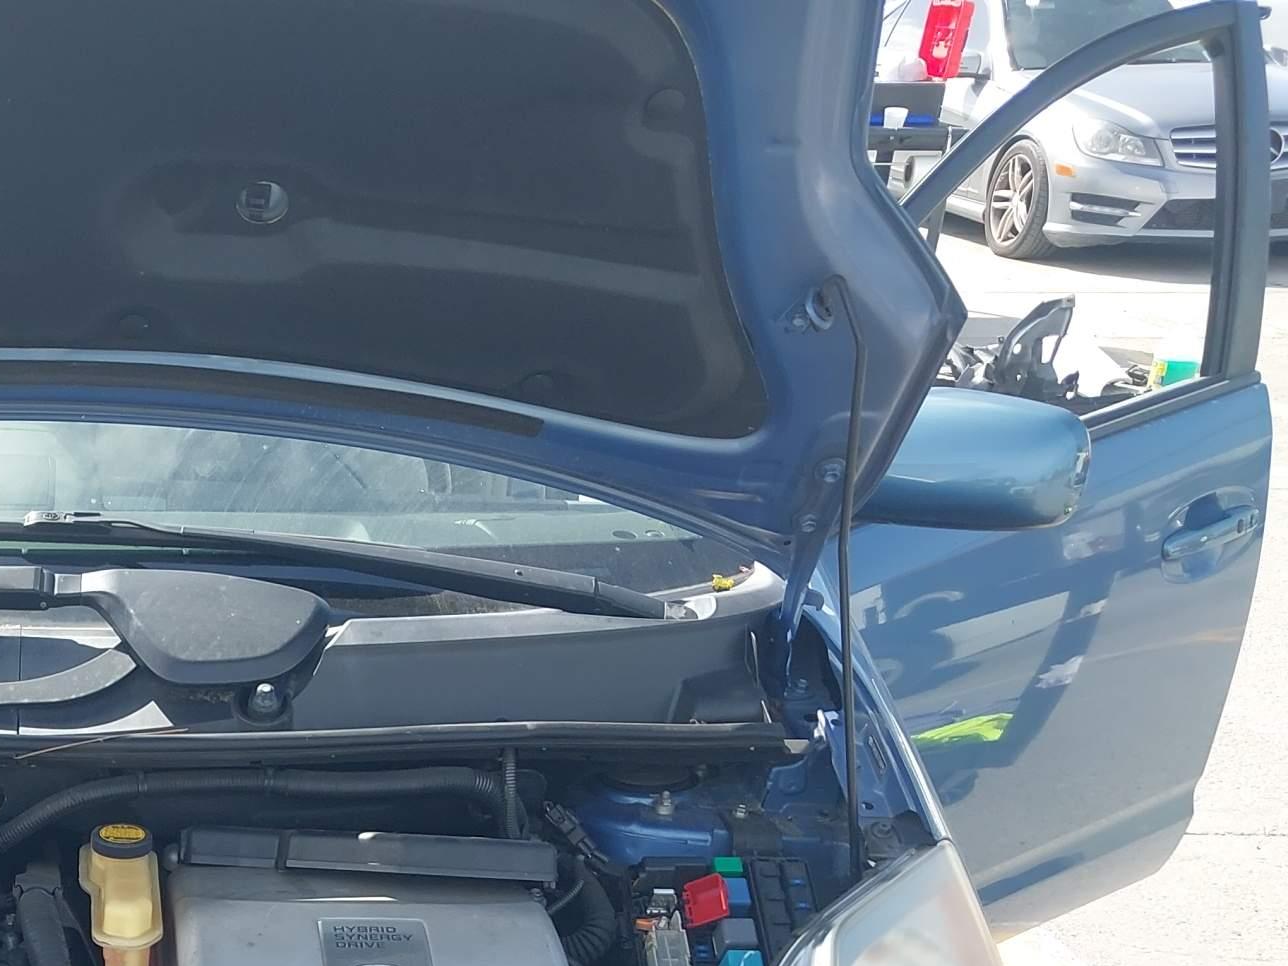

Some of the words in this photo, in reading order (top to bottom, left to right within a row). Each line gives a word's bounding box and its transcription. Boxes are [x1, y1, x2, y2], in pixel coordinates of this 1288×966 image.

[333, 925, 397, 934] HYBRID
[334, 933, 414, 942] SYNERGY
[335, 941, 385, 949] DRIVE
